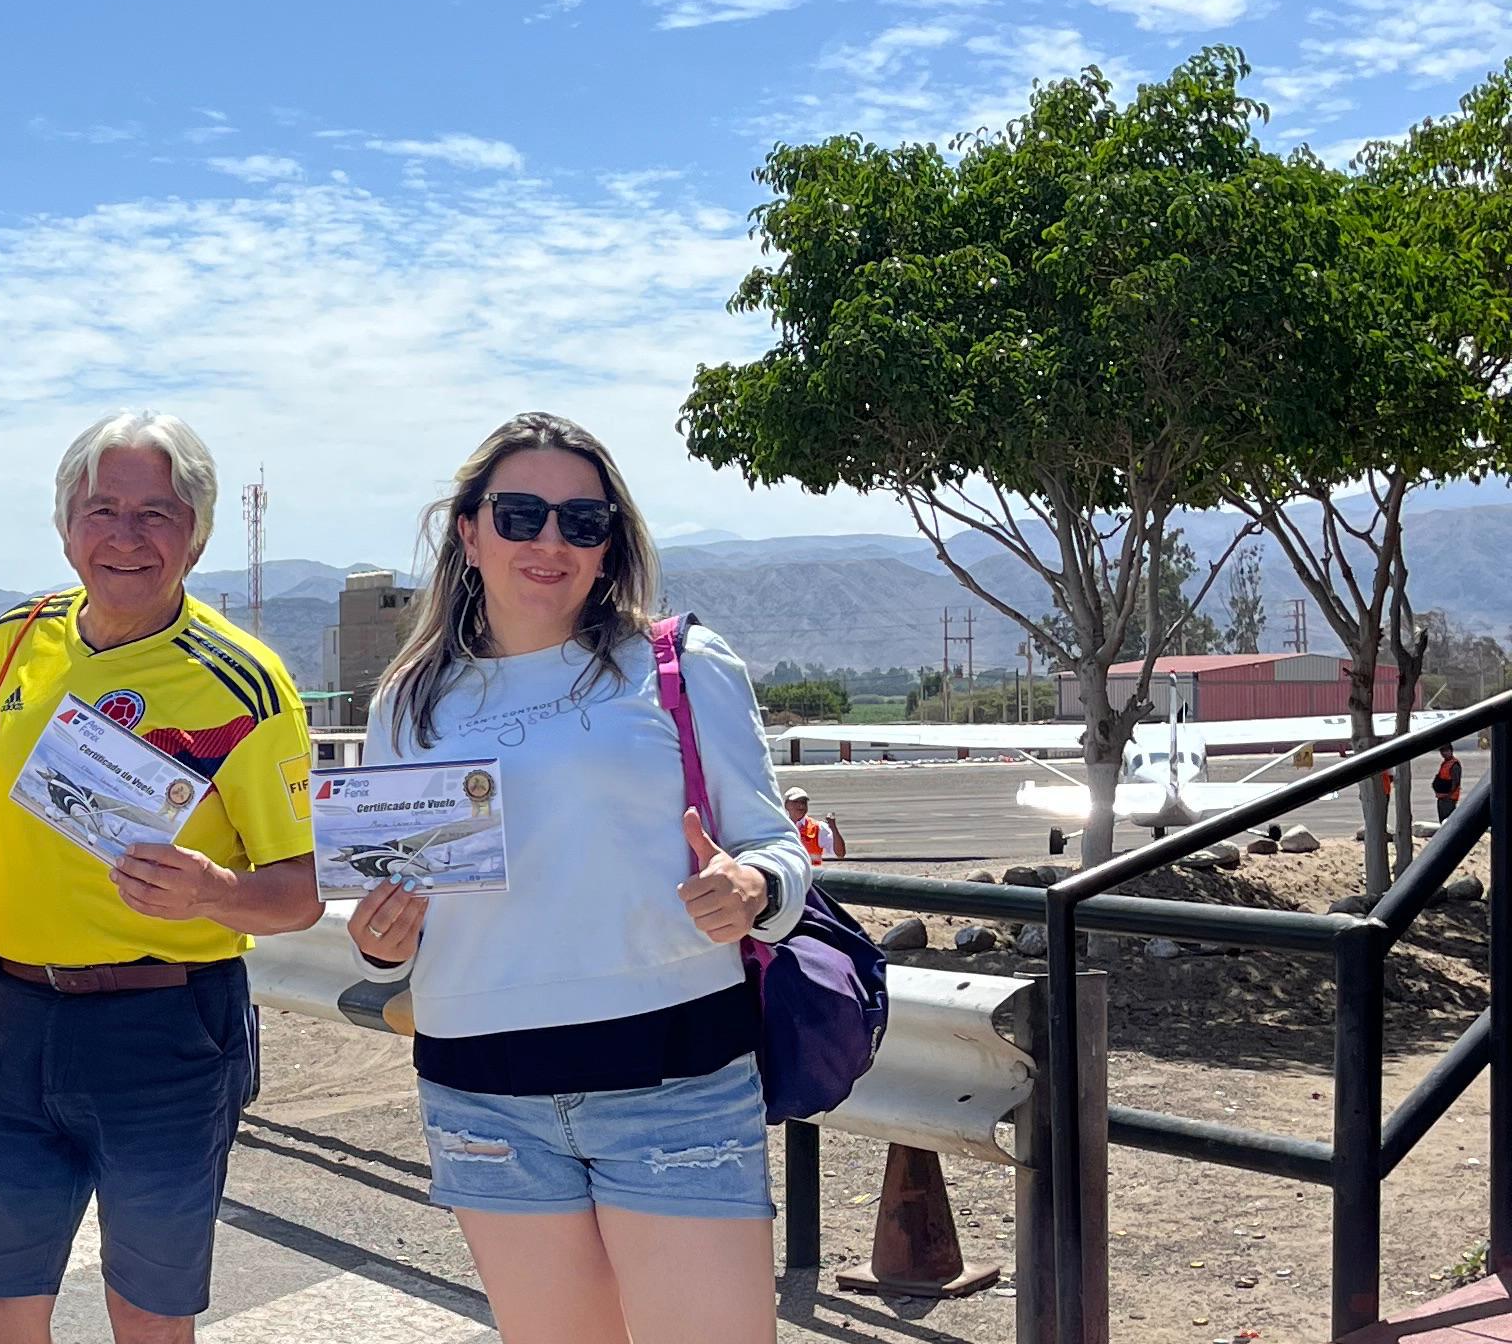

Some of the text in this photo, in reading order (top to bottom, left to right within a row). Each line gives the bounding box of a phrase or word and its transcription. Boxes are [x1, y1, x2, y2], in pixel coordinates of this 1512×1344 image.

[85, 720, 105, 736] Aero
[79, 744, 123, 775] Certificado
[121, 771, 133, 782] de
[131, 777, 155, 796] Vuelo
[289, 778, 309, 794] FIF
[346, 779, 370, 788] Aero
[357, 798, 456, 813] Certificado de Vuelo
